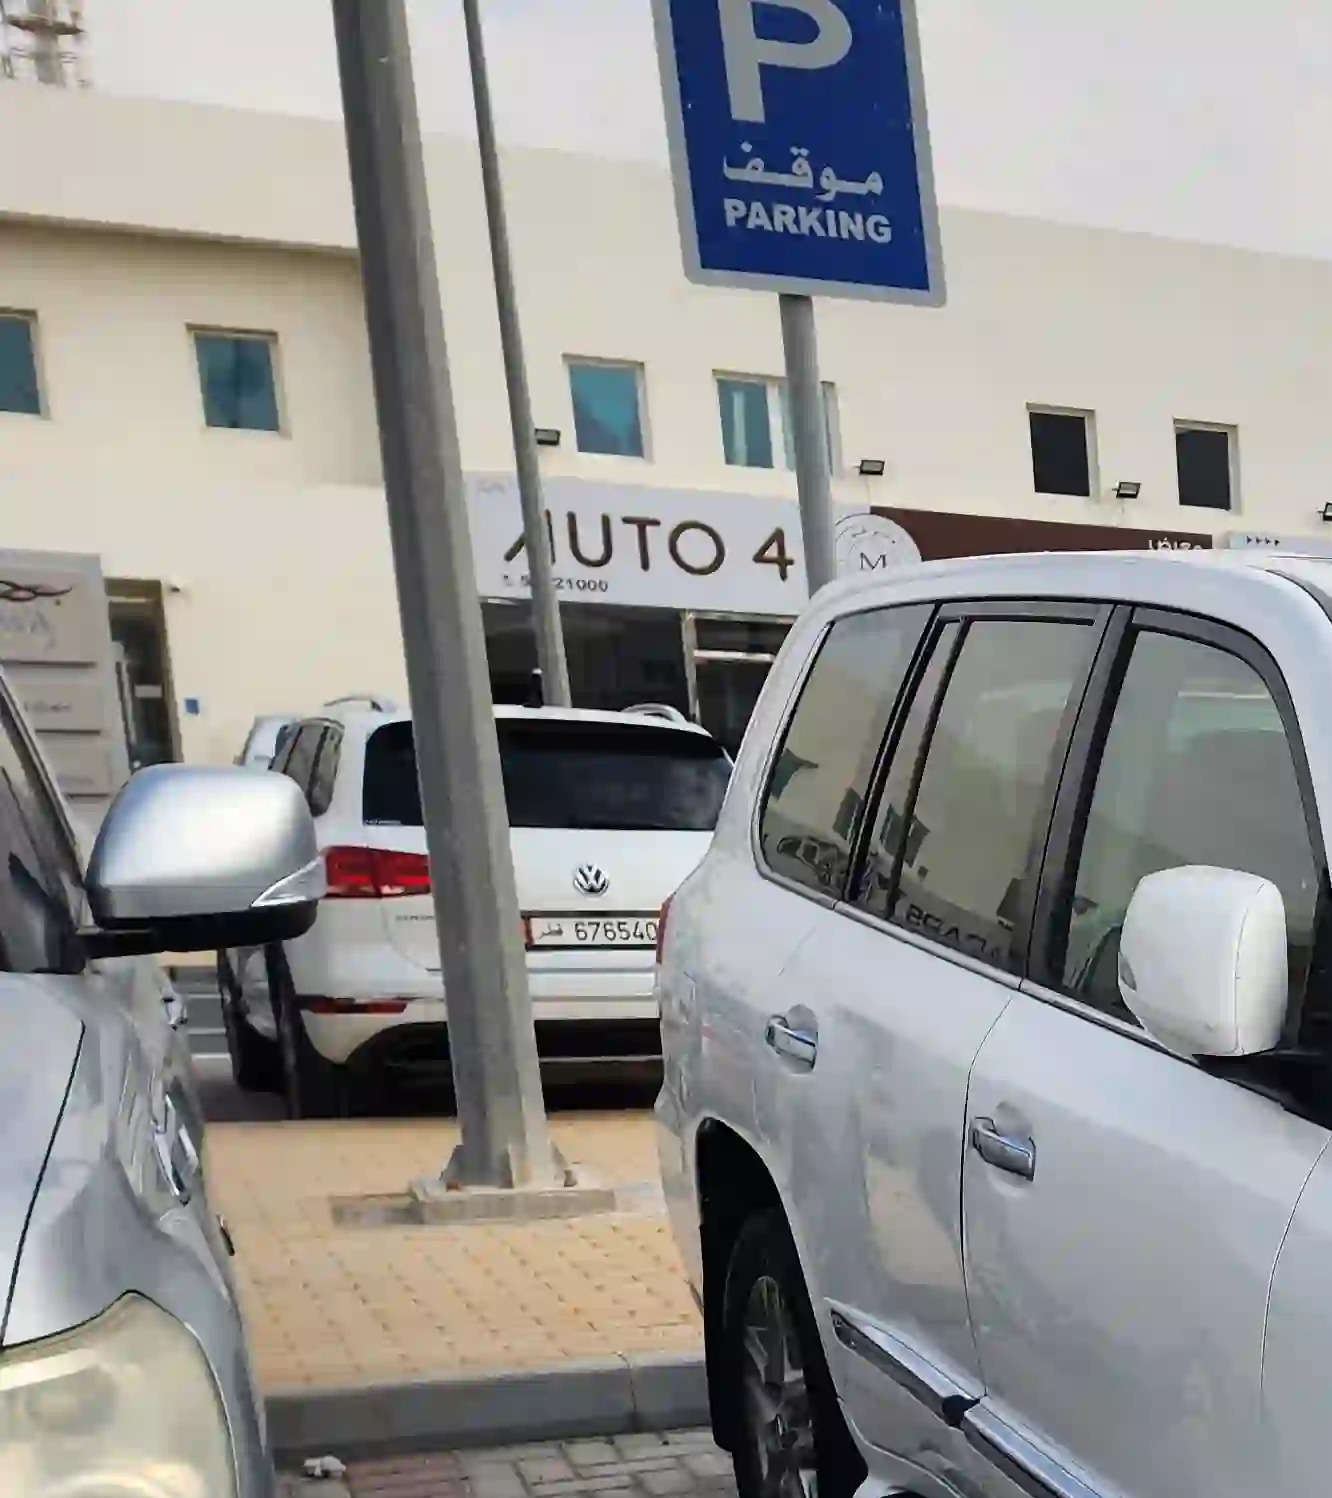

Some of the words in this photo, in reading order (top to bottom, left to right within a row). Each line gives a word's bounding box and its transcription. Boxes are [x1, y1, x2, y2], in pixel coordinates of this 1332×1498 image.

[718, 0, 853, 125] P
[722, 141, 884, 202] موقف
[722, 198, 893, 244] PARKING
[751, 526, 796, 583] 4
[574, 920, 658, 942] 676540
